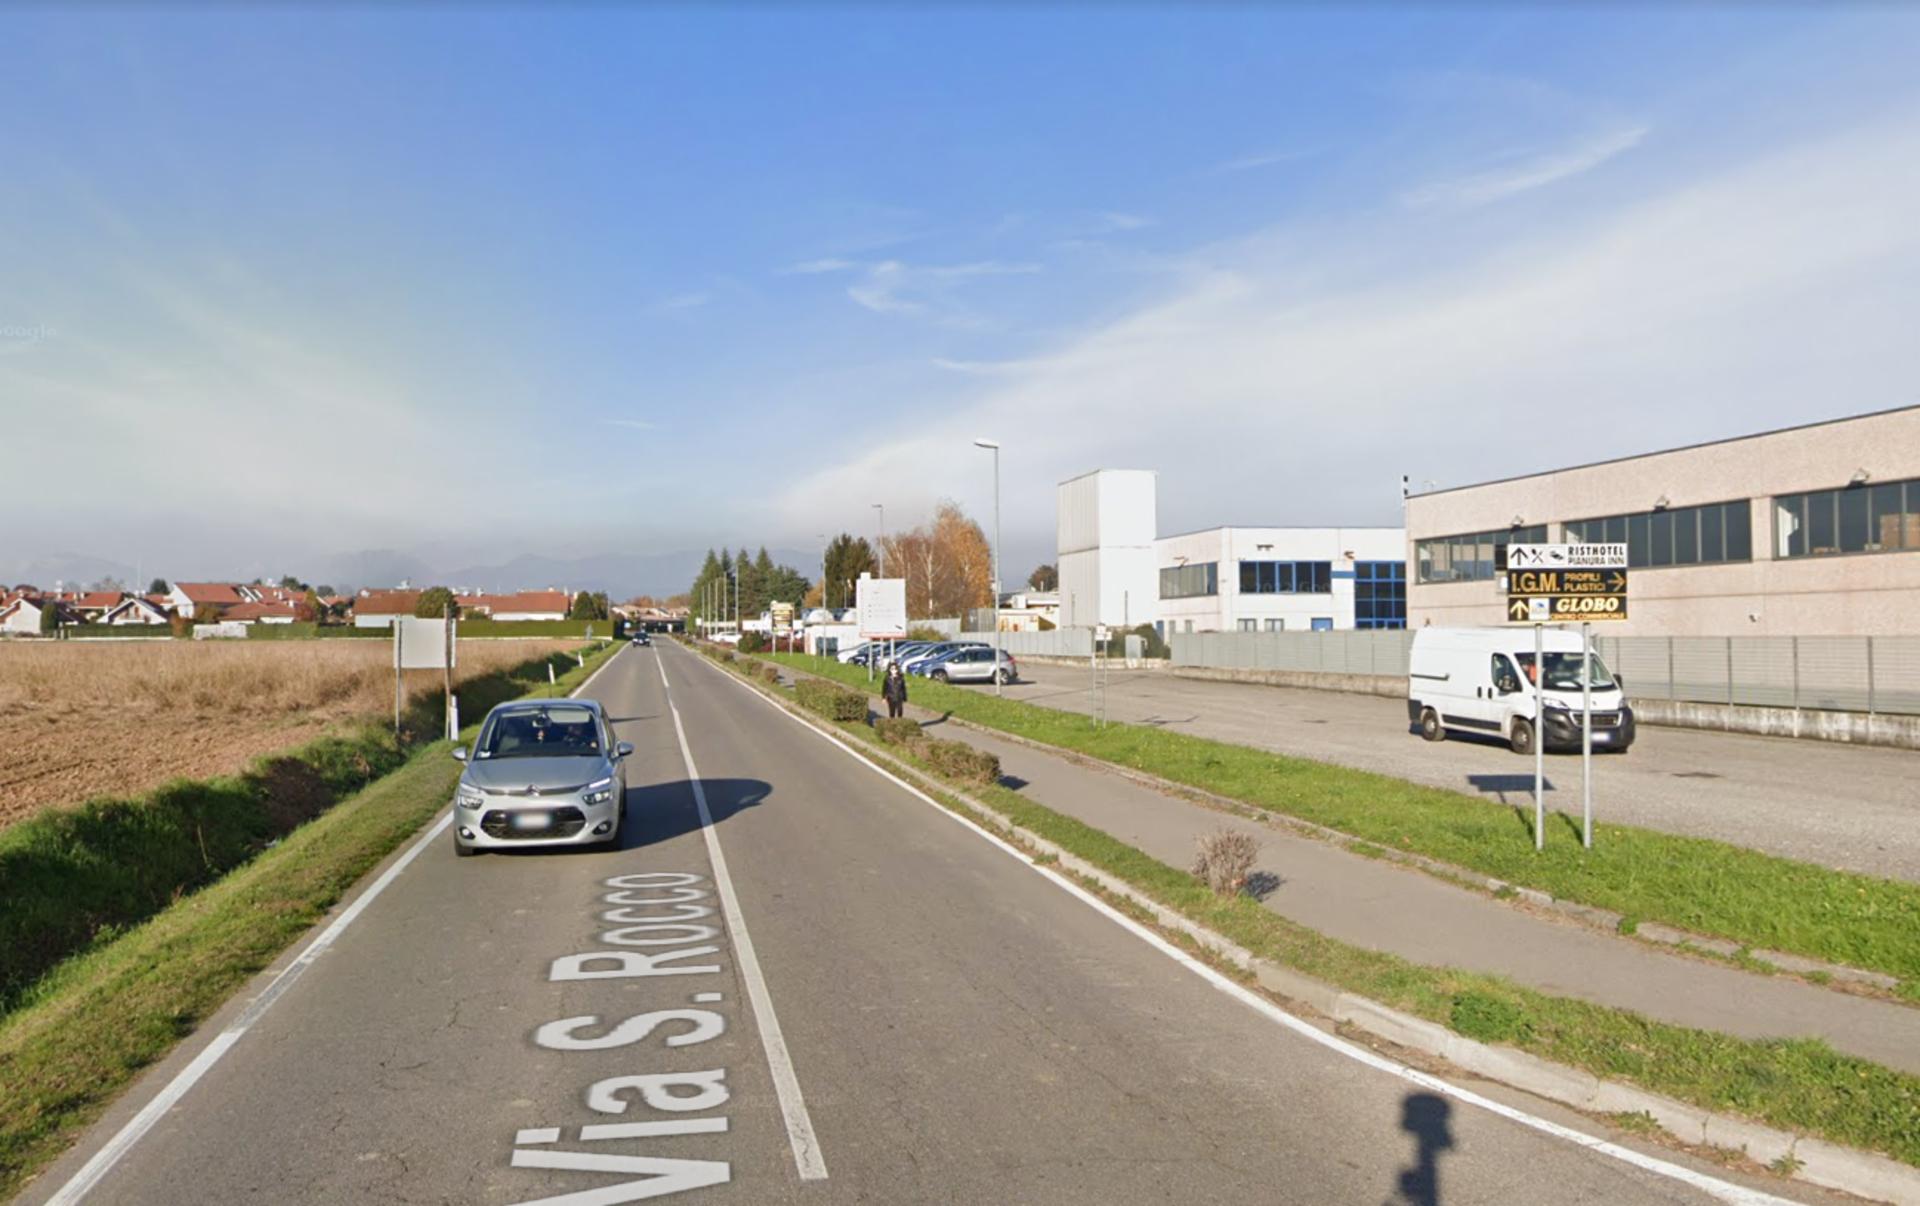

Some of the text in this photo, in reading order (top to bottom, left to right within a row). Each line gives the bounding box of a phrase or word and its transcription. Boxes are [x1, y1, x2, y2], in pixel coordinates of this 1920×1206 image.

[1568, 546, 1623, 556] RISTHOTEL
[1568, 556, 1625, 565] PIANURA INN
[1511, 573, 1561, 592] I.G.M.
[1564, 583, 1606, 591] PLASTICI
[1556, 597, 1619, 612] GLOBO
[505, 872, 731, 1206] Via S. Rocco
